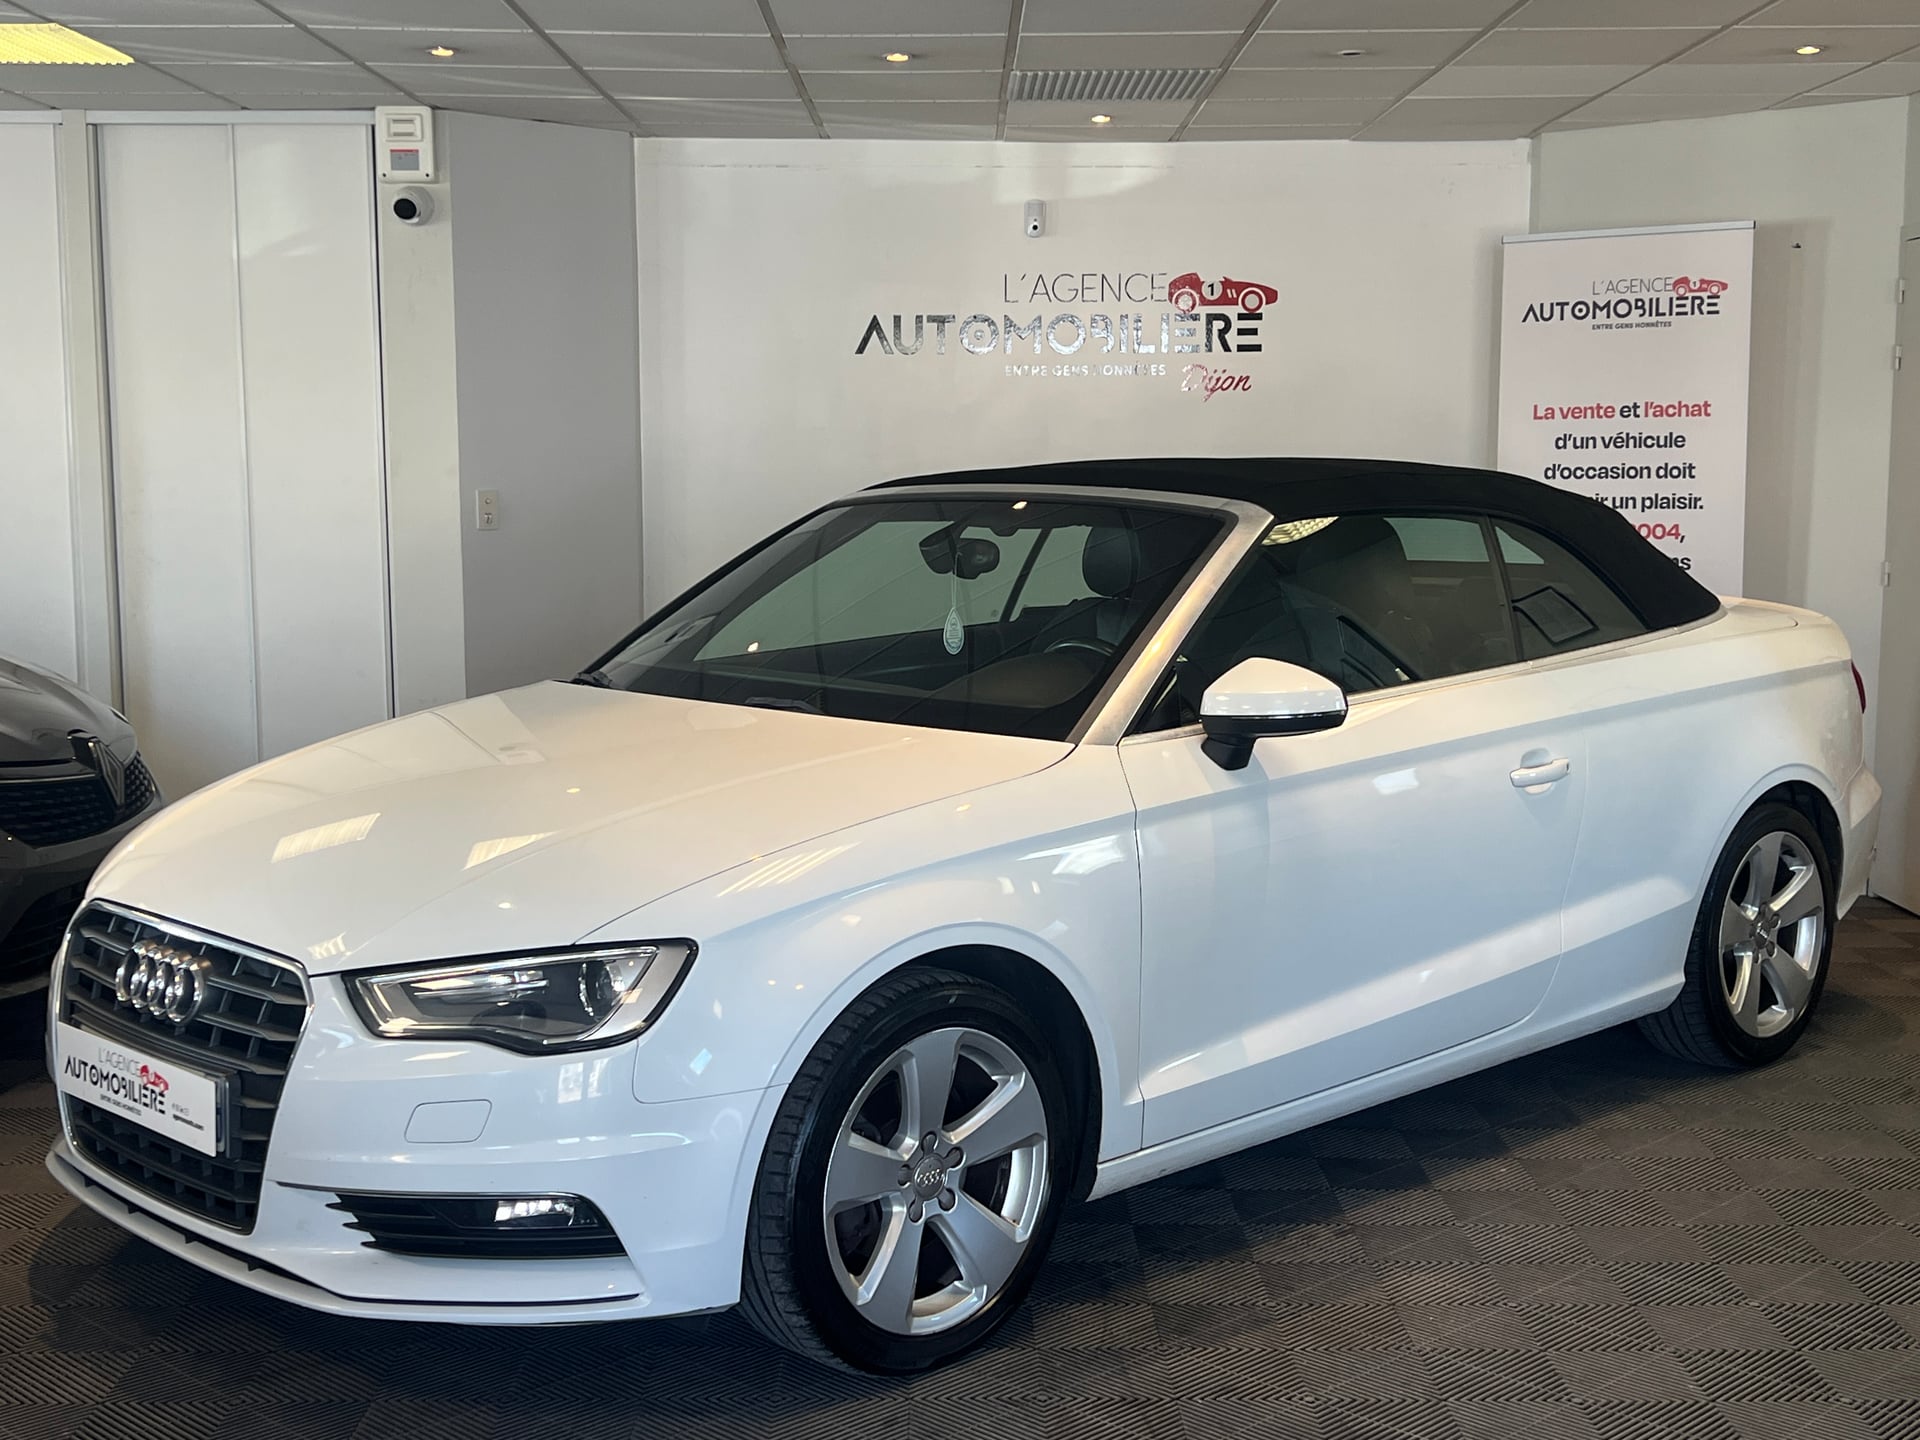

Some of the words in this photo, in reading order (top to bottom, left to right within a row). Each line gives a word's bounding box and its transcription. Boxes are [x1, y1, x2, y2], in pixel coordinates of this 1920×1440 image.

[1003, 273, 1168, 304] L'AGENCE
[1207, 281, 1216, 297] 1
[1592, 277, 1674, 296] L'AGENCE
[1635, 320, 1672, 329] HONNÊTES
[1004, 364, 1048, 377] ENTRE
[1181, 363, 1252, 402] Dijon
[1533, 404, 1556, 420] La
[1559, 403, 1616, 419] vente
[1619, 402, 1641, 418] et
[1644, 401, 1711, 418] l'achat
[1554, 434, 1597, 450] d'un
[1601, 432, 1686, 449] véhicule
[1543, 463, 1651, 480] d'occasion
[1655, 462, 1696, 479] doit
[1612, 496, 1637, 510] un
[1641, 493, 1704, 512] plaisir.
[1632, 523, 1686, 543] 004,
